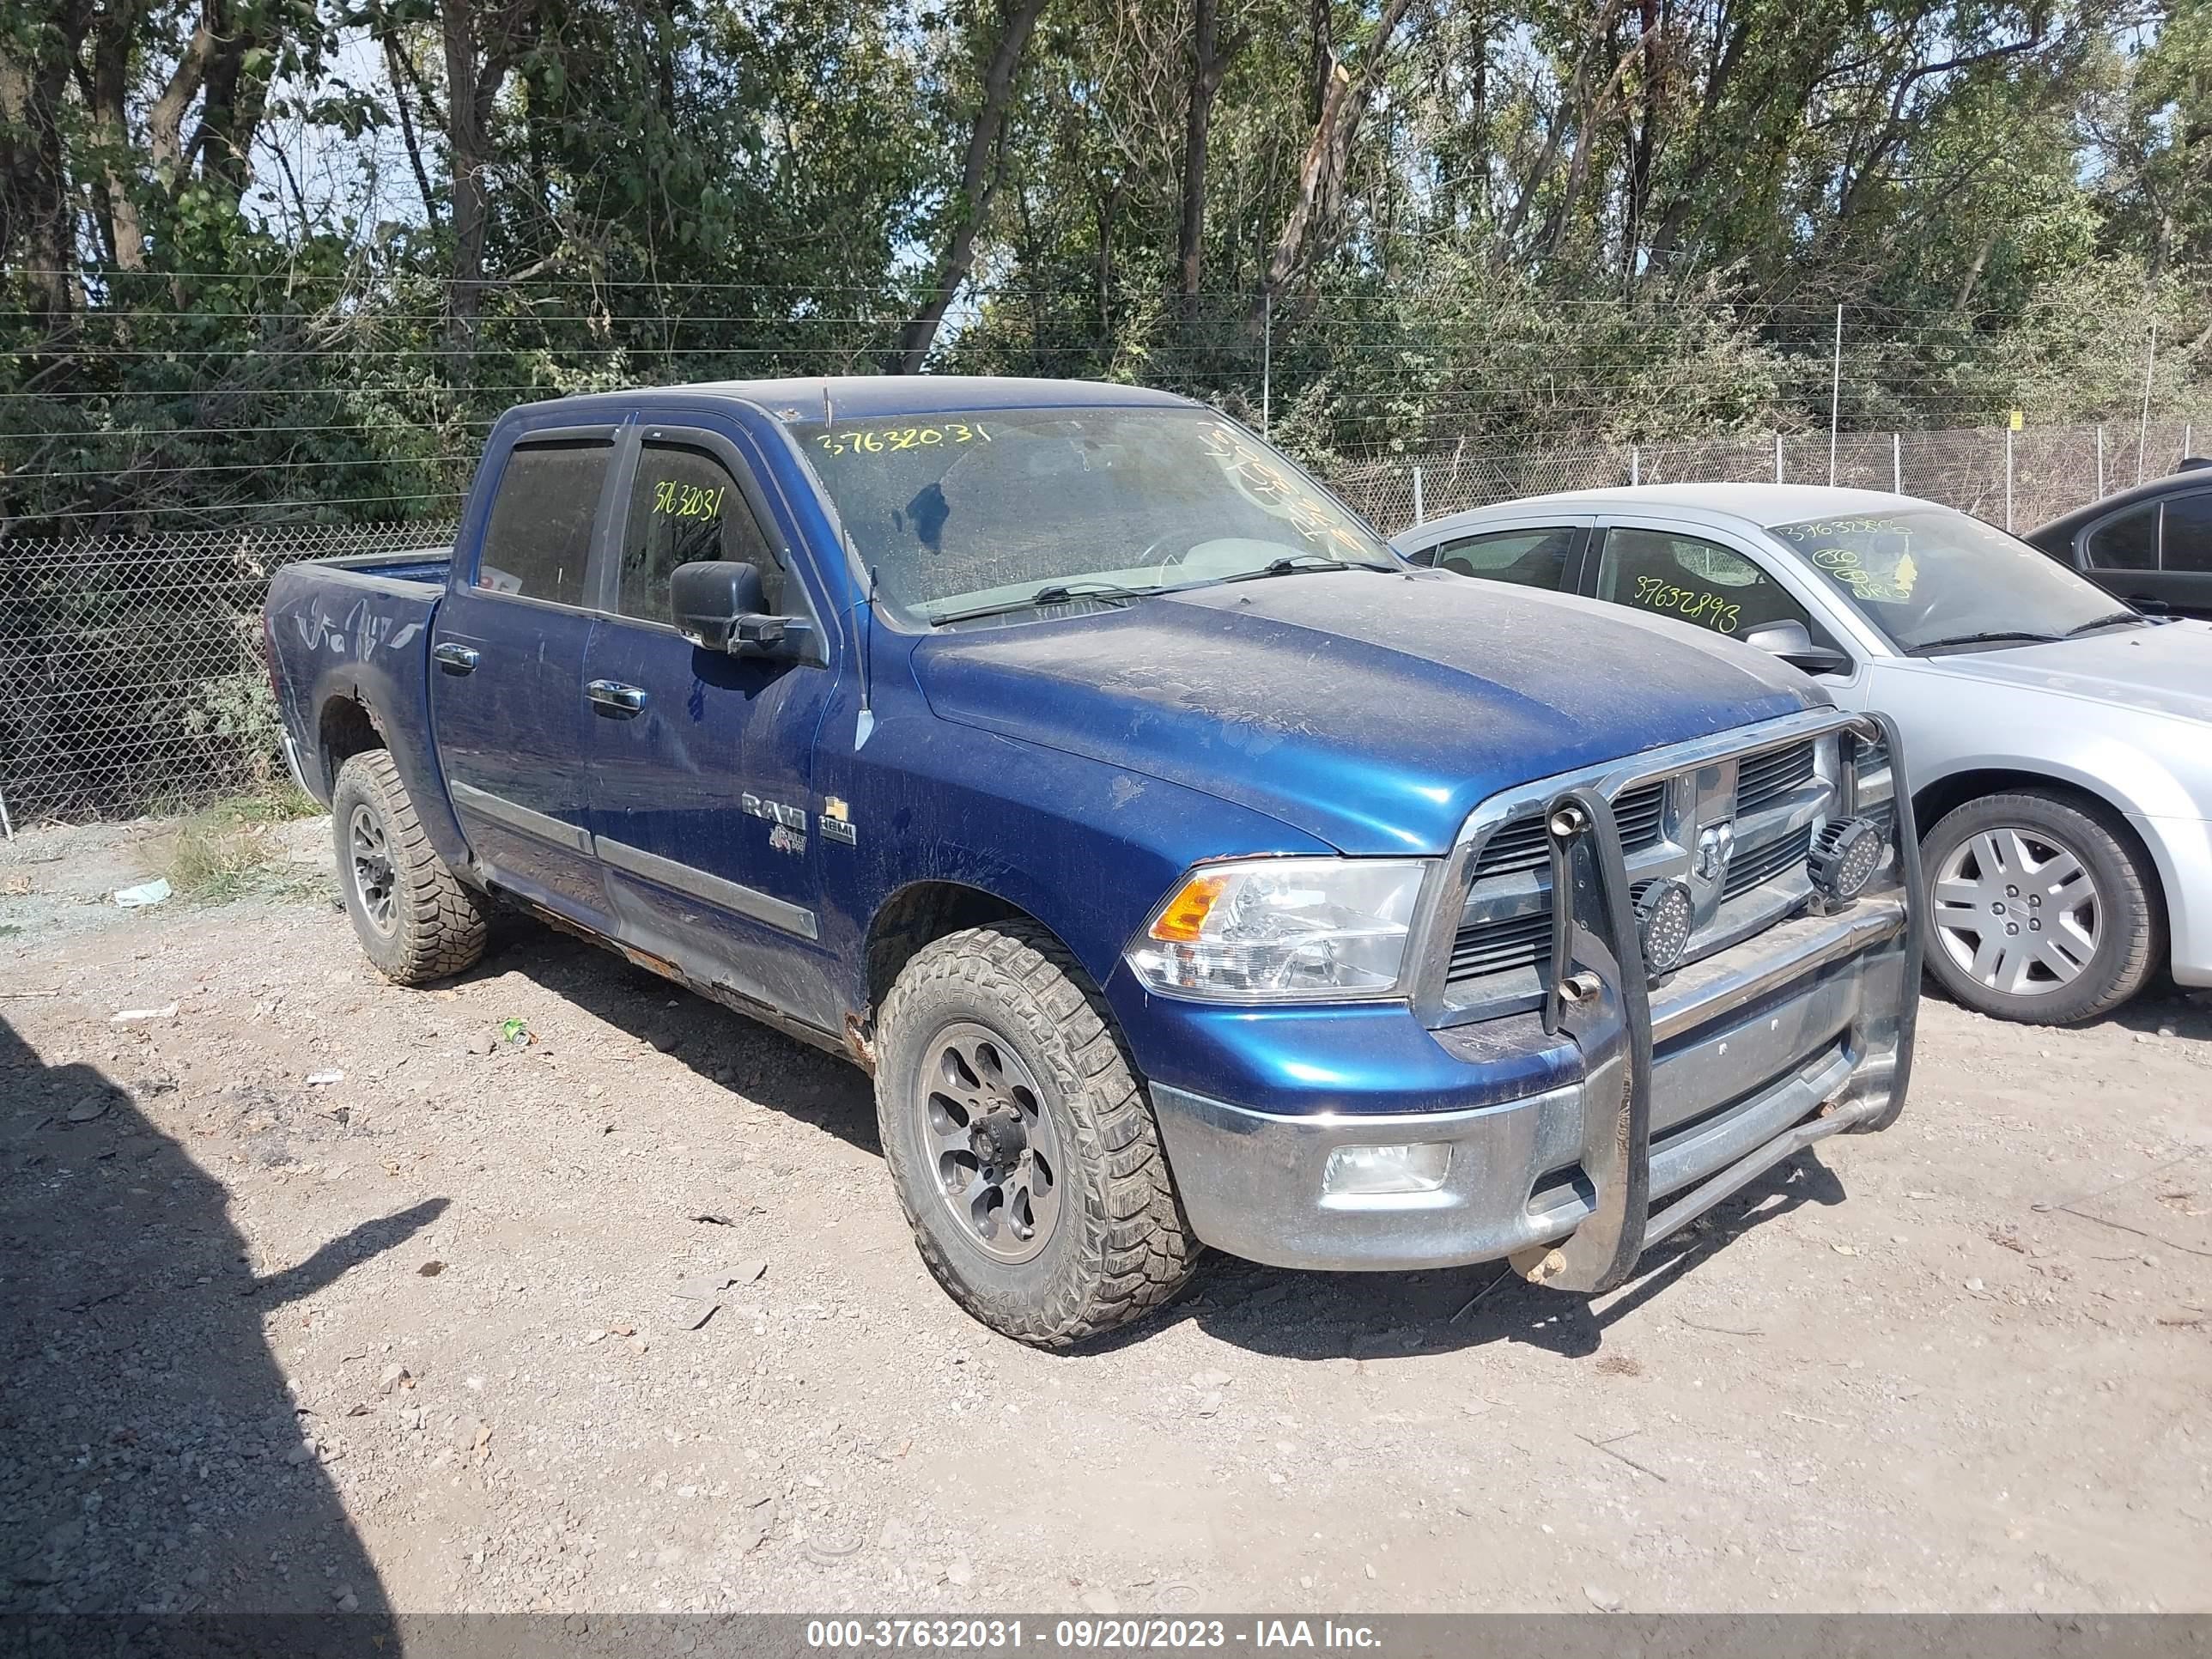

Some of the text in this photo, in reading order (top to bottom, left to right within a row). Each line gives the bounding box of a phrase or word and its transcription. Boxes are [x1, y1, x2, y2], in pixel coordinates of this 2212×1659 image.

[817, 424, 992, 455] 37632031
[653, 480, 725, 522] 37632031
[1634, 576, 1741, 634] 37632893
[742, 791, 805, 830] RAM
[819, 817, 855, 837] HEMI
